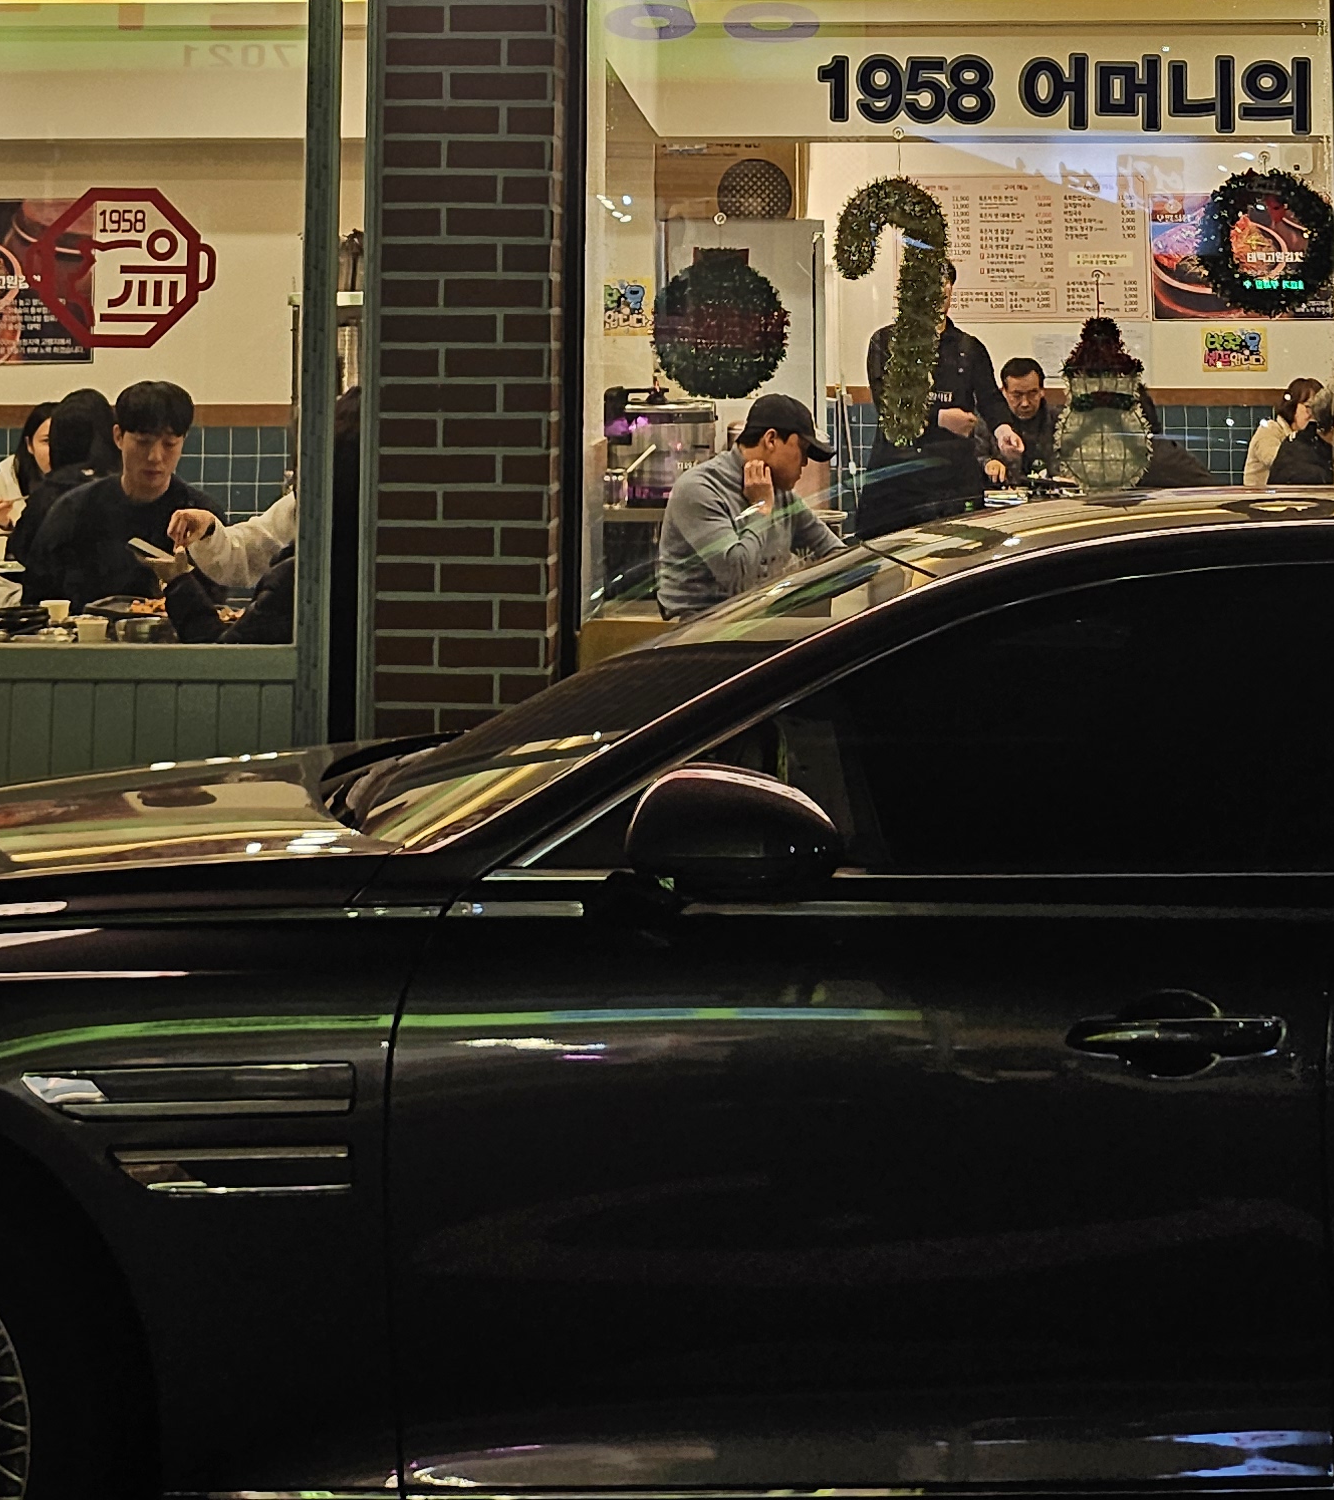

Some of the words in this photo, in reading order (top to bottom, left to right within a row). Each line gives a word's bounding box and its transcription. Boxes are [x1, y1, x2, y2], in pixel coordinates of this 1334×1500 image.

[818, 53, 996, 125] 1958
[1018, 52, 1312, 135] 어머니의
[99, 209, 146, 233] 1958
